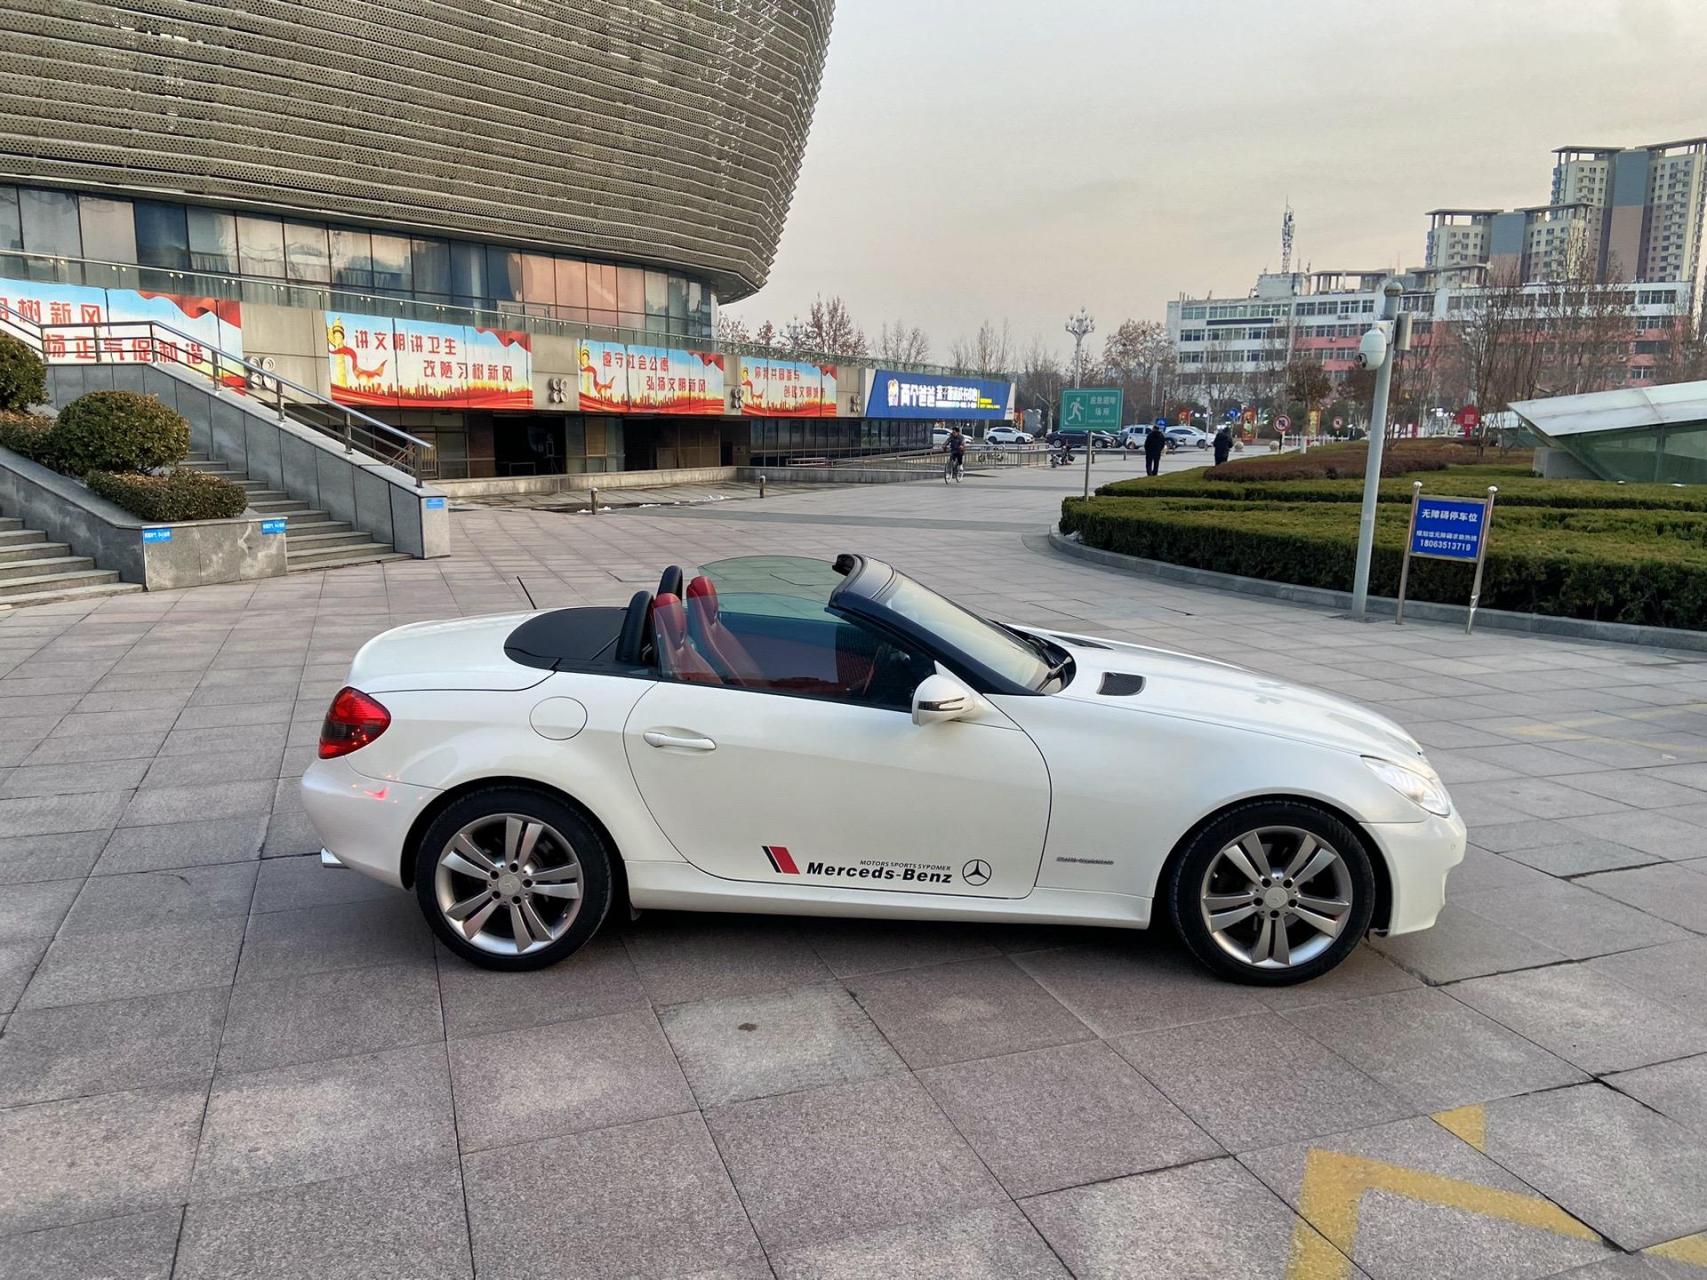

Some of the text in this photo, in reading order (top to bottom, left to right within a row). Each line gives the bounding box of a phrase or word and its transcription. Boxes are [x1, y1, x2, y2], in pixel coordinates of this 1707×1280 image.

[354, 329, 457, 356] 讲文明讲卫生
[423, 360, 513, 382] 改陋习树新风
[602, 351, 669, 372] 遵守社会公德
[646, 375, 706, 392] 弘扬文明新风
[1421, 509, 1478, 522] 无障碍停车位
[806, 862, 952, 884] Merceds-Benz
